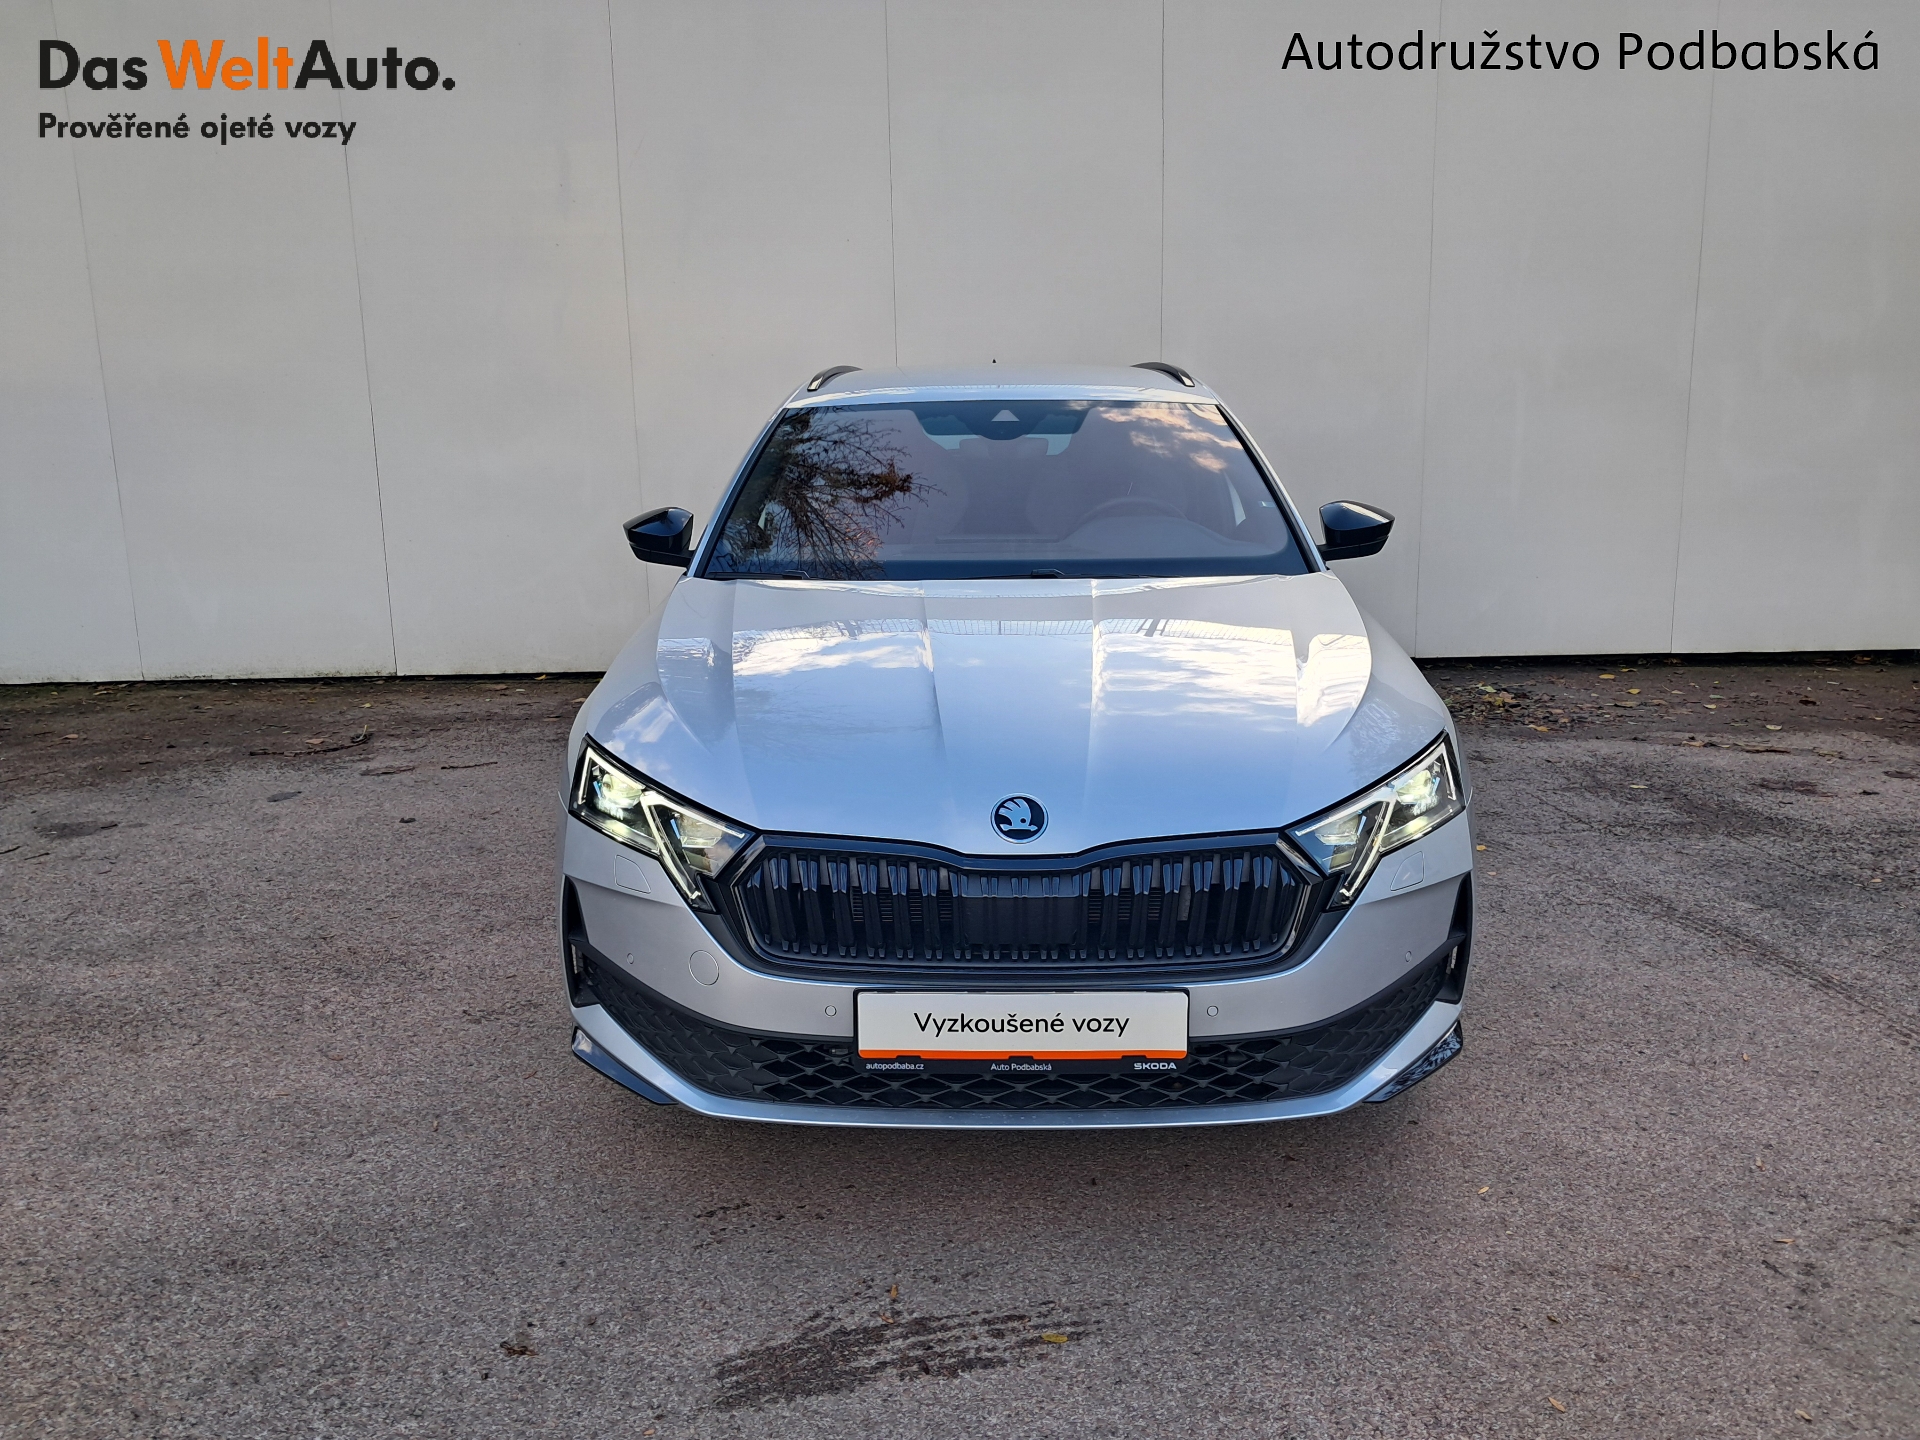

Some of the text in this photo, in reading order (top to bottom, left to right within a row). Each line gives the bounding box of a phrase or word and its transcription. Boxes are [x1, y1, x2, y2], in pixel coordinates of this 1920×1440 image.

[913, 1012, 1130, 1038] Vyzkoušené vozy
[865, 1062, 925, 1071] autopodbaba.cz
[990, 1062, 1052, 1071] Auto Podbabská
